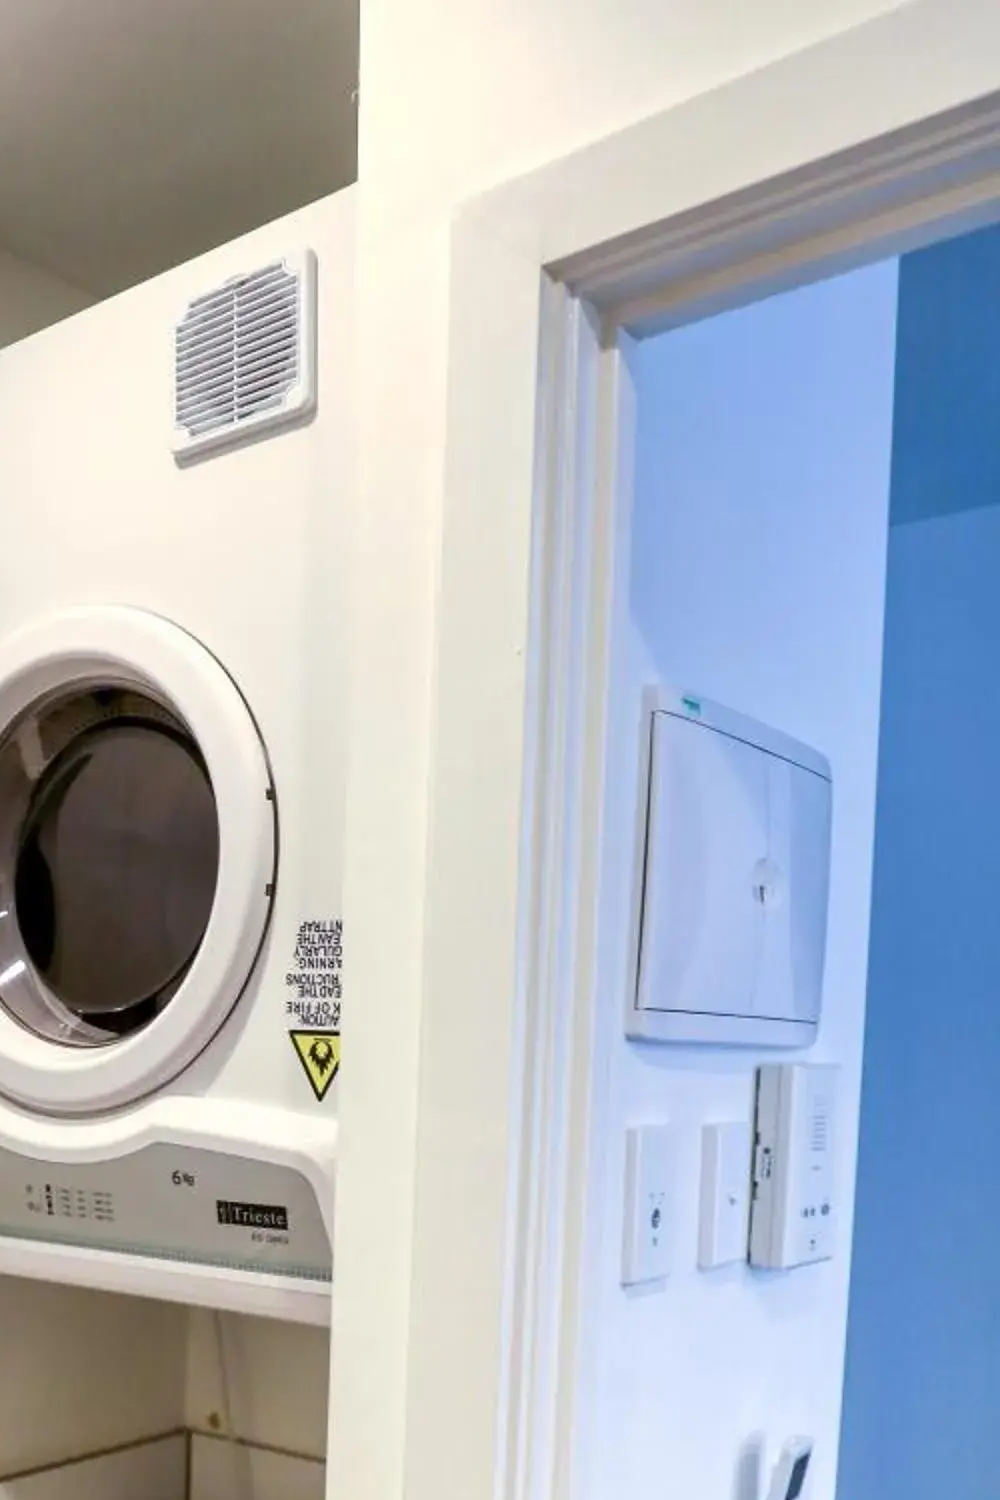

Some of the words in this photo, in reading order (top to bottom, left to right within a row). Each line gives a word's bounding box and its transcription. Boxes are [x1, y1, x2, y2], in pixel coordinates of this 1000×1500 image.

[297, 933, 316, 944] THE
[317, 934, 341, 944] EAN
[294, 946, 342, 958] GULARLY
[295, 957, 343, 970] ARNING:
[286, 973, 339, 985] RUCTIONS
[298, 986, 318, 998] THE
[319, 986, 341, 998] EAD
[286, 1001, 311, 1014] FIRE
[314, 1002, 331, 1015] OF
[298, 1014, 341, 1027] AUTION:
[233, 1207, 286, 1225] Trieste
